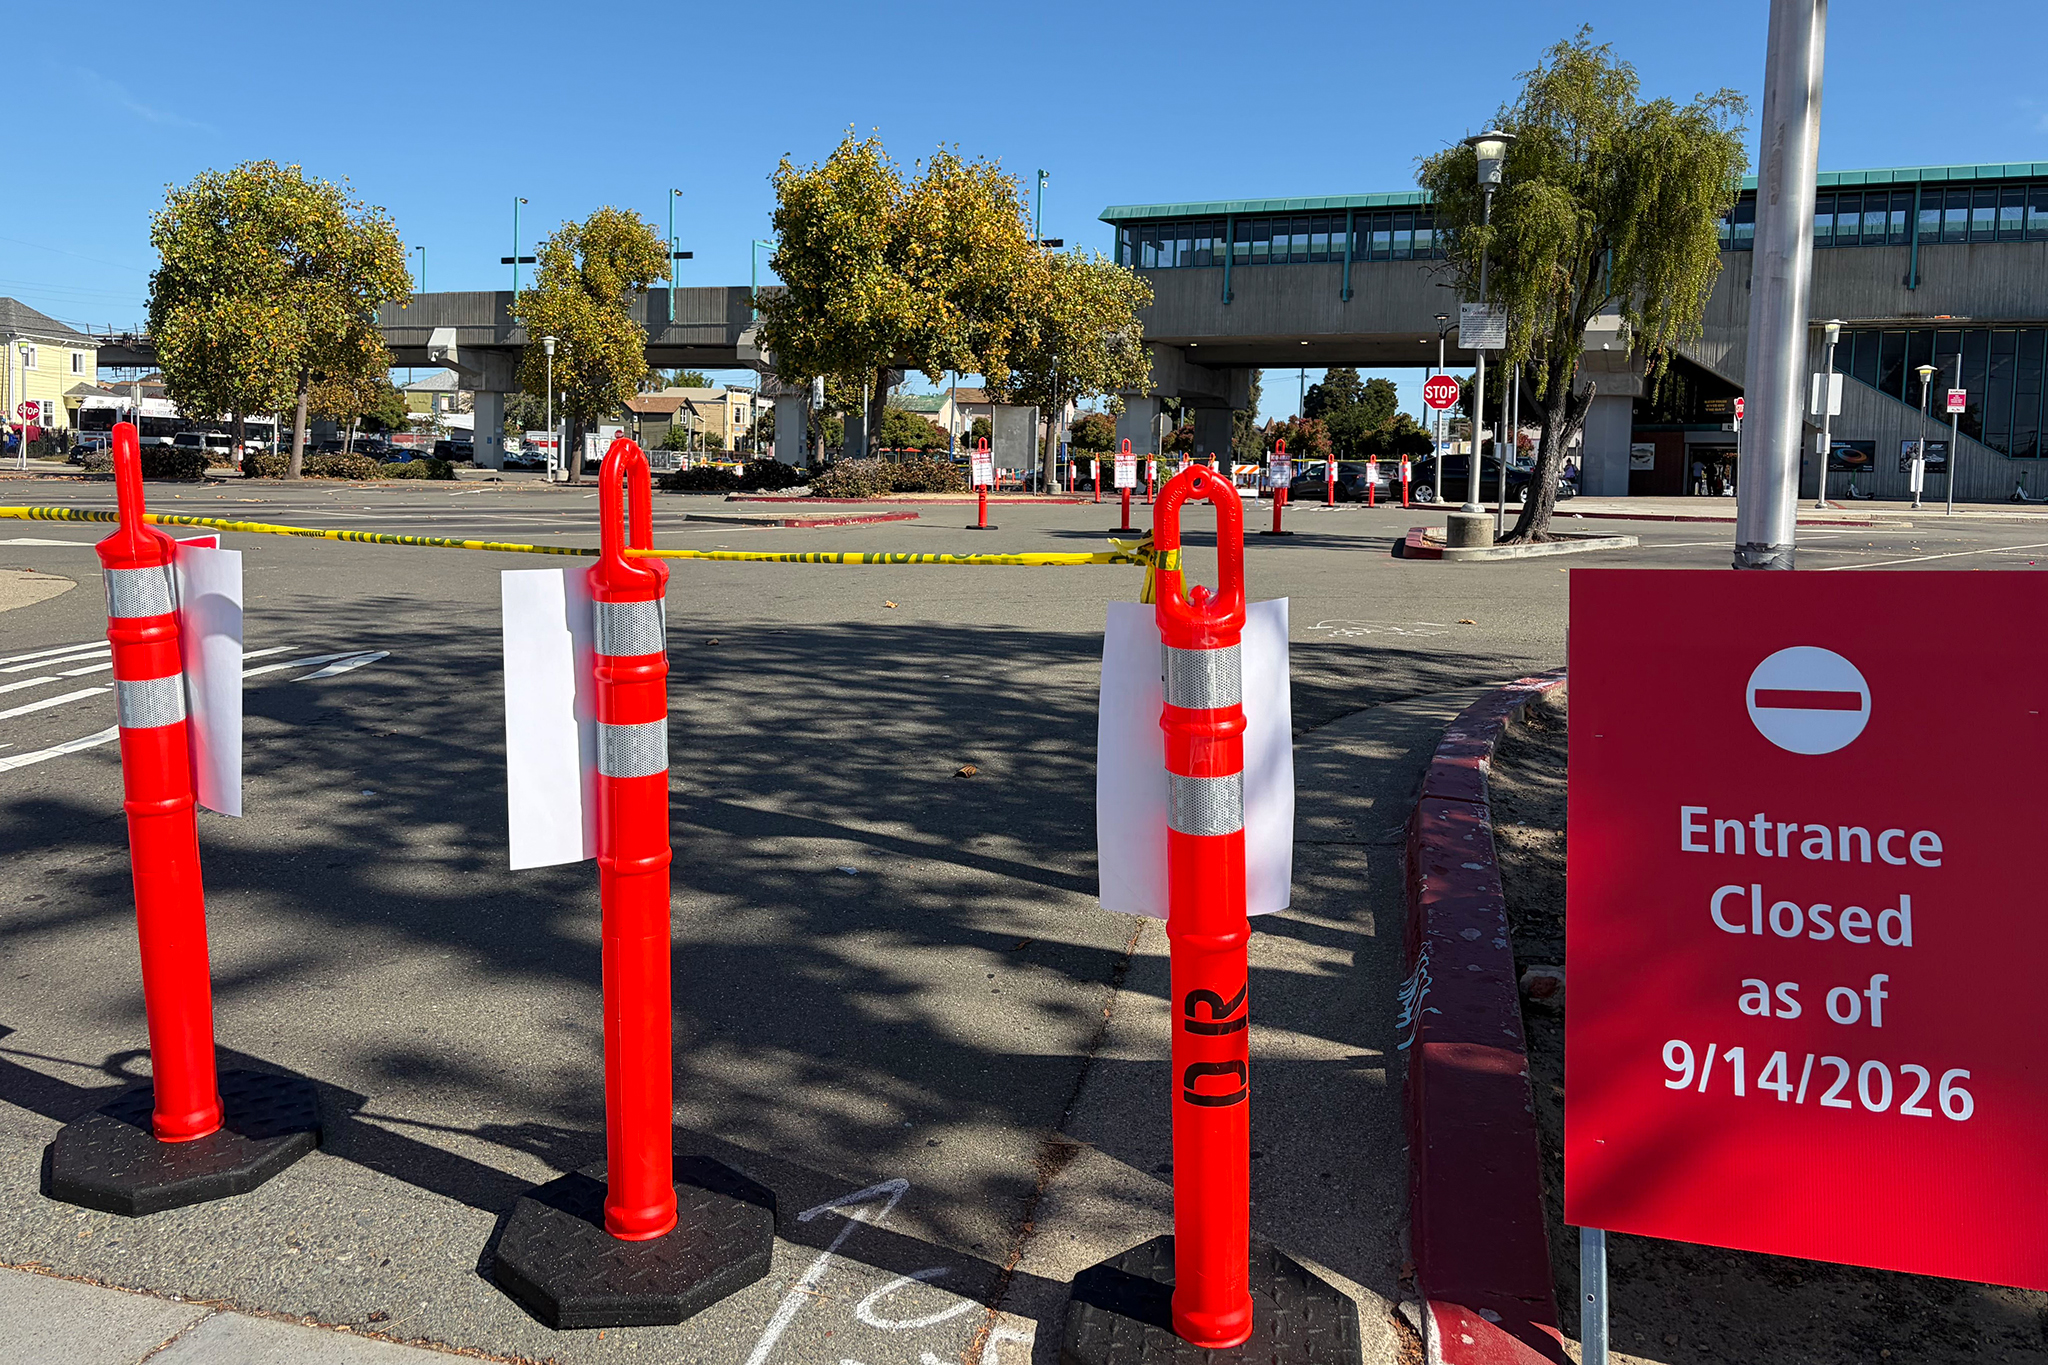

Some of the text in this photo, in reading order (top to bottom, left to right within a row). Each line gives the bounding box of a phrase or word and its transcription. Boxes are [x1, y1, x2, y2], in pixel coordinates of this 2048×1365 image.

[18, 406, 39, 415] STOP
[1425, 385, 1457, 399] STOP
[1681, 806, 1942, 867] Entrance
[1711, 884, 1912, 946] Closed
[1739, 974, 1888, 1027] as of
[1183, 981, 1247, 1107] DR
[1663, 1040, 1974, 1121] 9/14/2026
